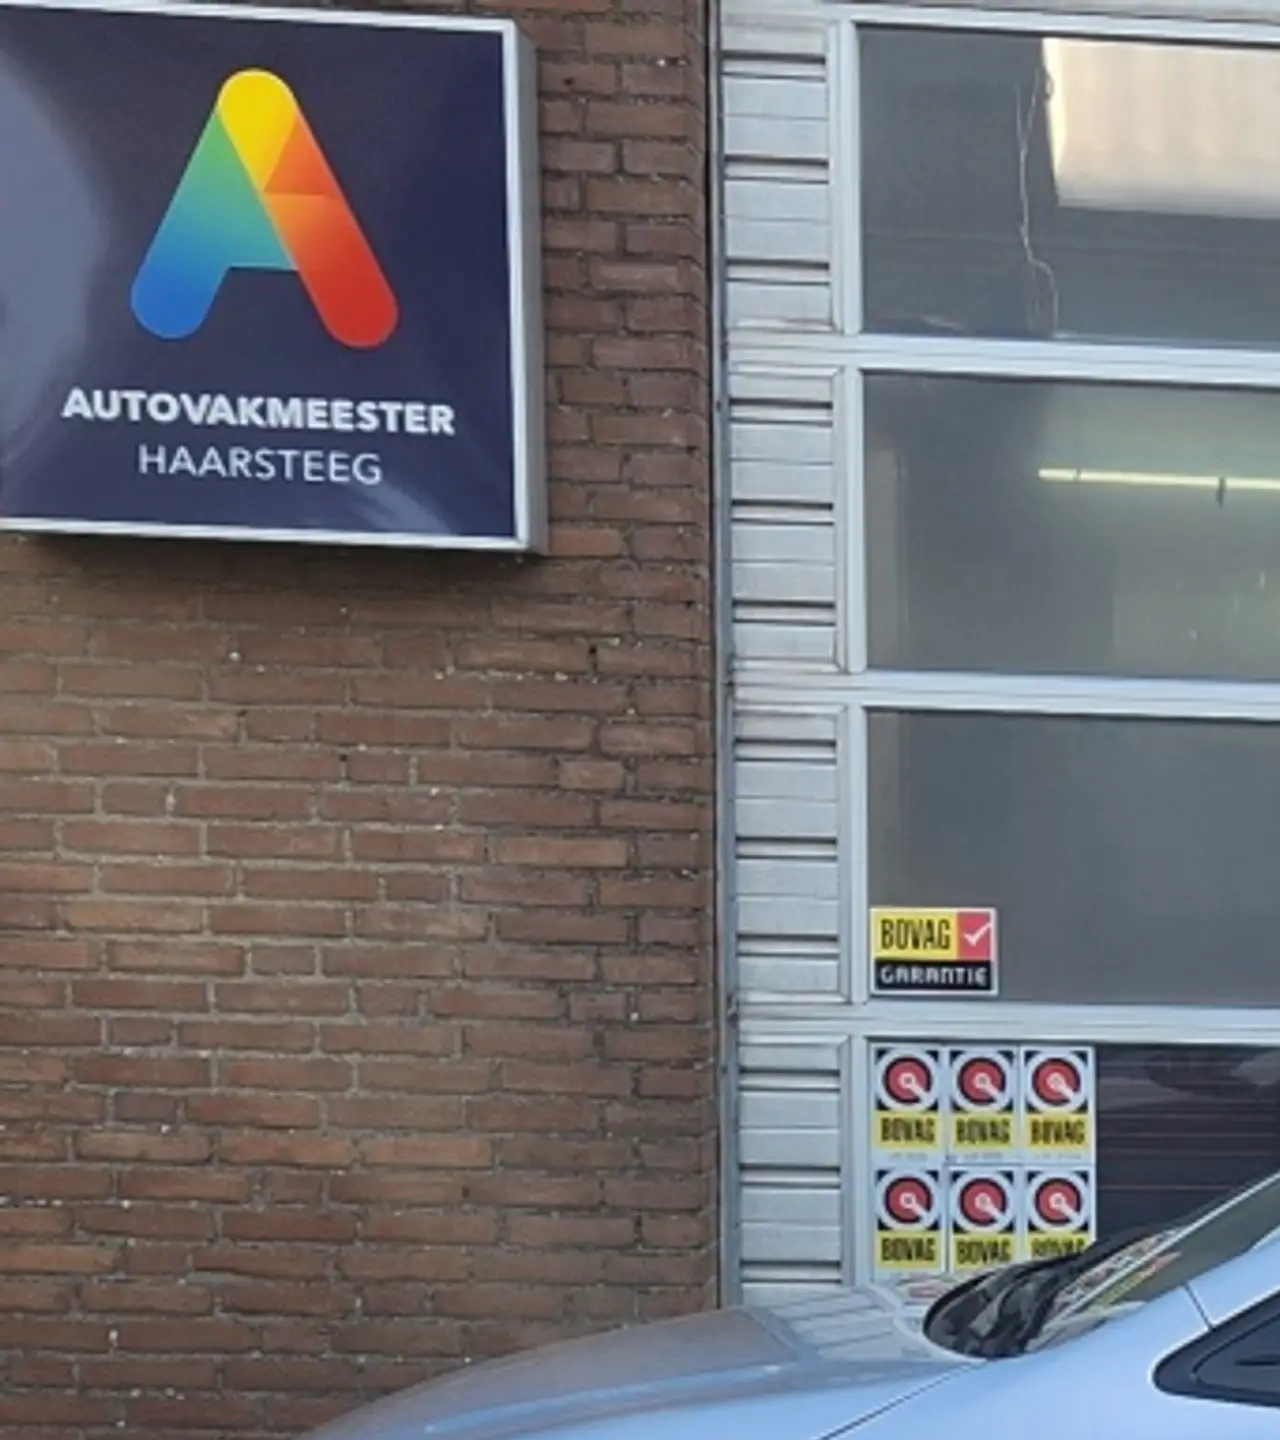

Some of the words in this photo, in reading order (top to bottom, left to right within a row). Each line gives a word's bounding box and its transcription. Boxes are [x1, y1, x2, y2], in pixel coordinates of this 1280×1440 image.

[62, 387, 456, 436] AUTOVAKMEESTER
[138, 444, 382, 485] HAARSTEEG
[880, 918, 951, 951] BOVAG
[880, 965, 988, 987] GARANTIE
[881, 1116, 935, 1142] BOVAG
[956, 1117, 1011, 1144] BOVAG
[1031, 1117, 1085, 1145] BOVAG
[881, 1236, 936, 1261] BOVAG
[956, 1238, 1011, 1264] BOVAG
